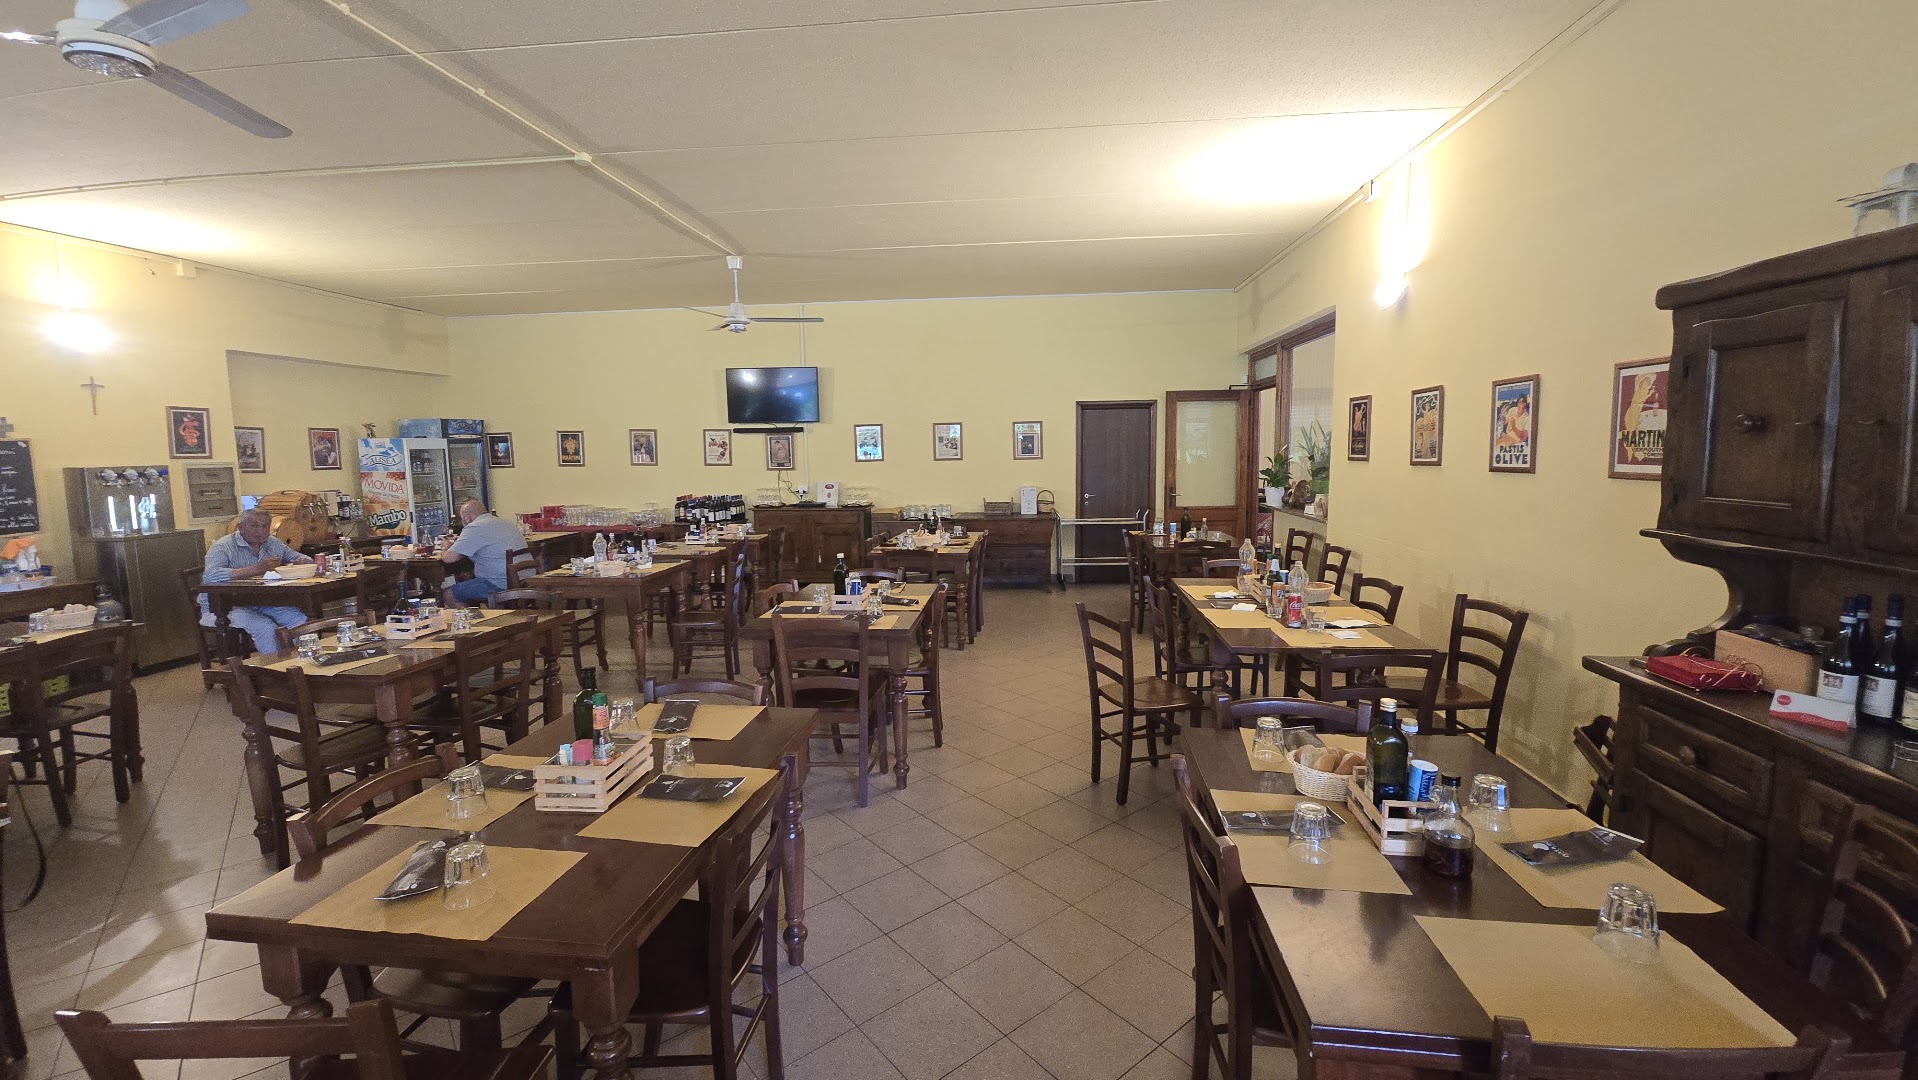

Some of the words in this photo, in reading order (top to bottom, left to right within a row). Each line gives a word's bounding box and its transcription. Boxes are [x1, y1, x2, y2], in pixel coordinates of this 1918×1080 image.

[1499, 444, 1524, 454] PASTIS
[1494, 453, 1528, 465] OLIVE
[364, 479, 405, 494] MOVIDA
[368, 509, 406, 527] Mambo
